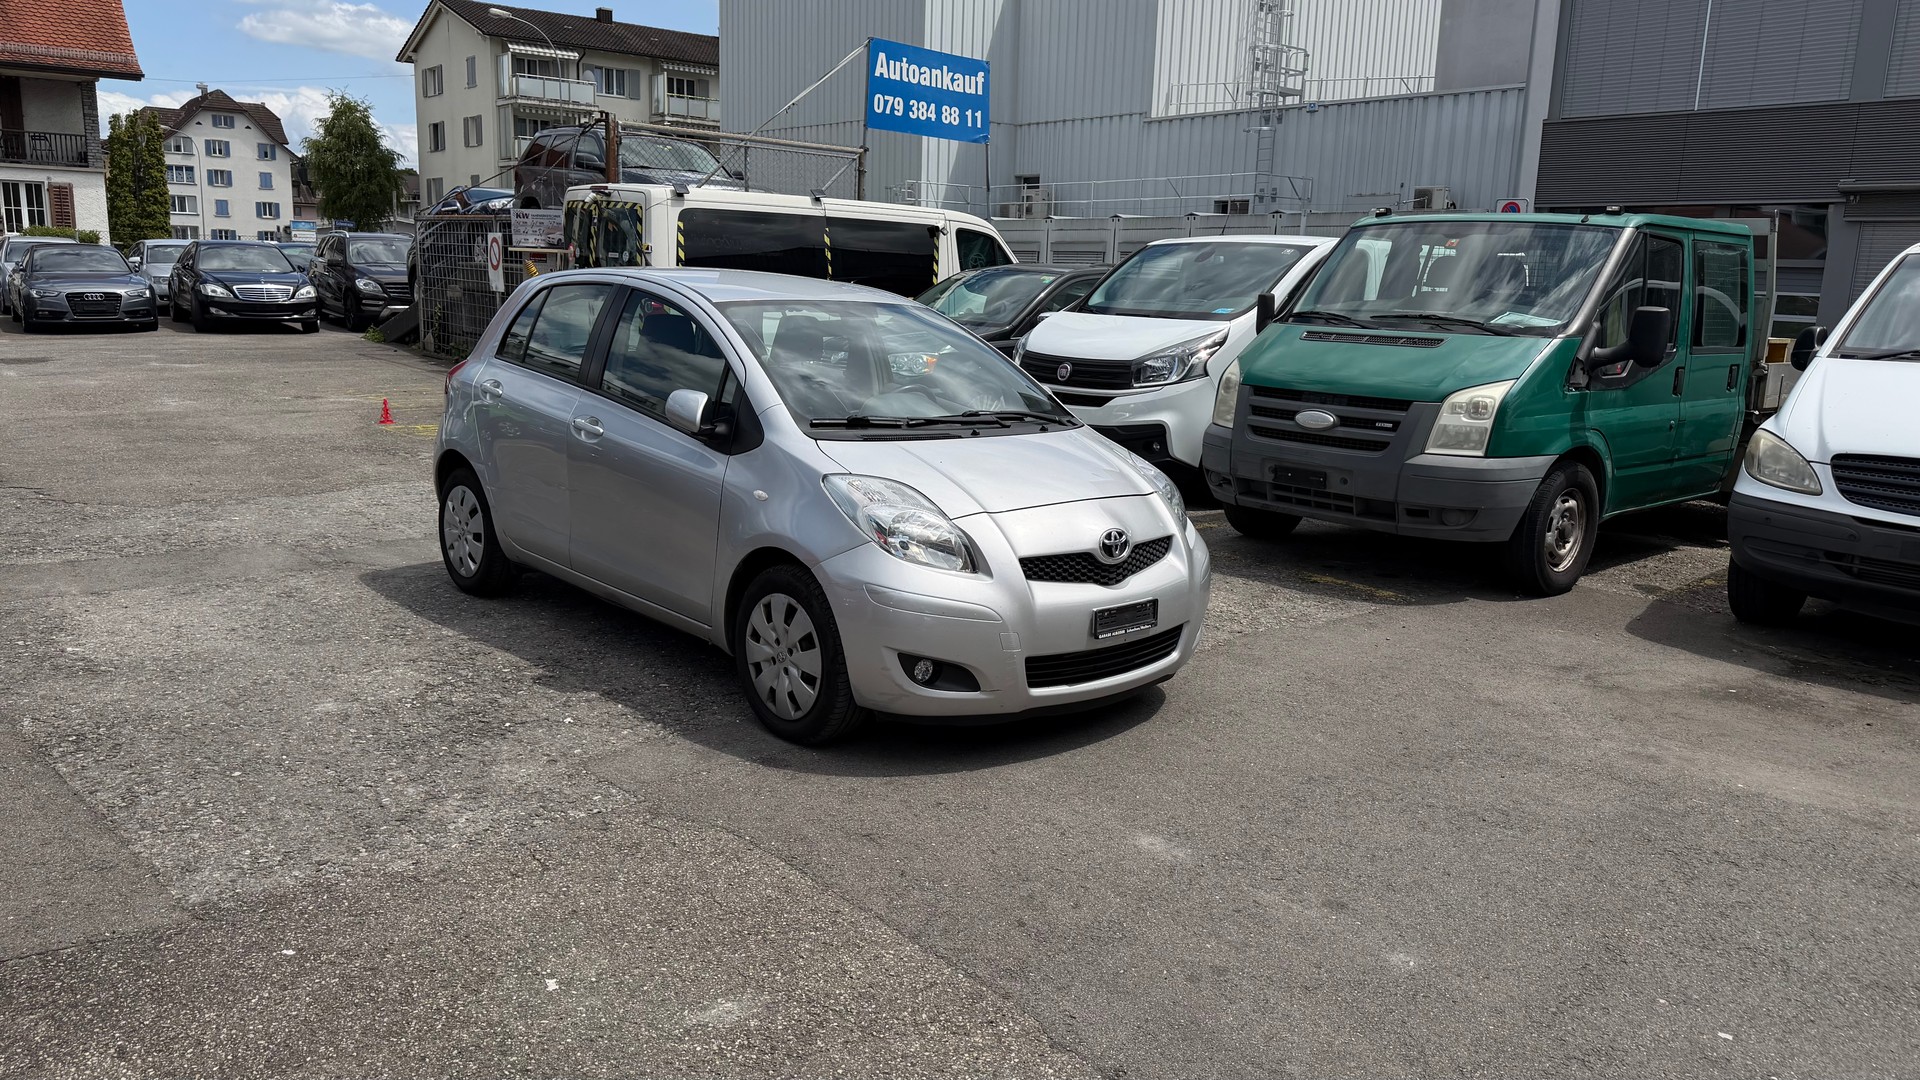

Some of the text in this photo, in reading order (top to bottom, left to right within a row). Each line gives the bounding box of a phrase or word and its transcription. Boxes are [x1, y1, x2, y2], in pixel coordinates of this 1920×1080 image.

[874, 52, 985, 95] Autoankauf
[873, 93, 982, 128] 079 384 88 11
